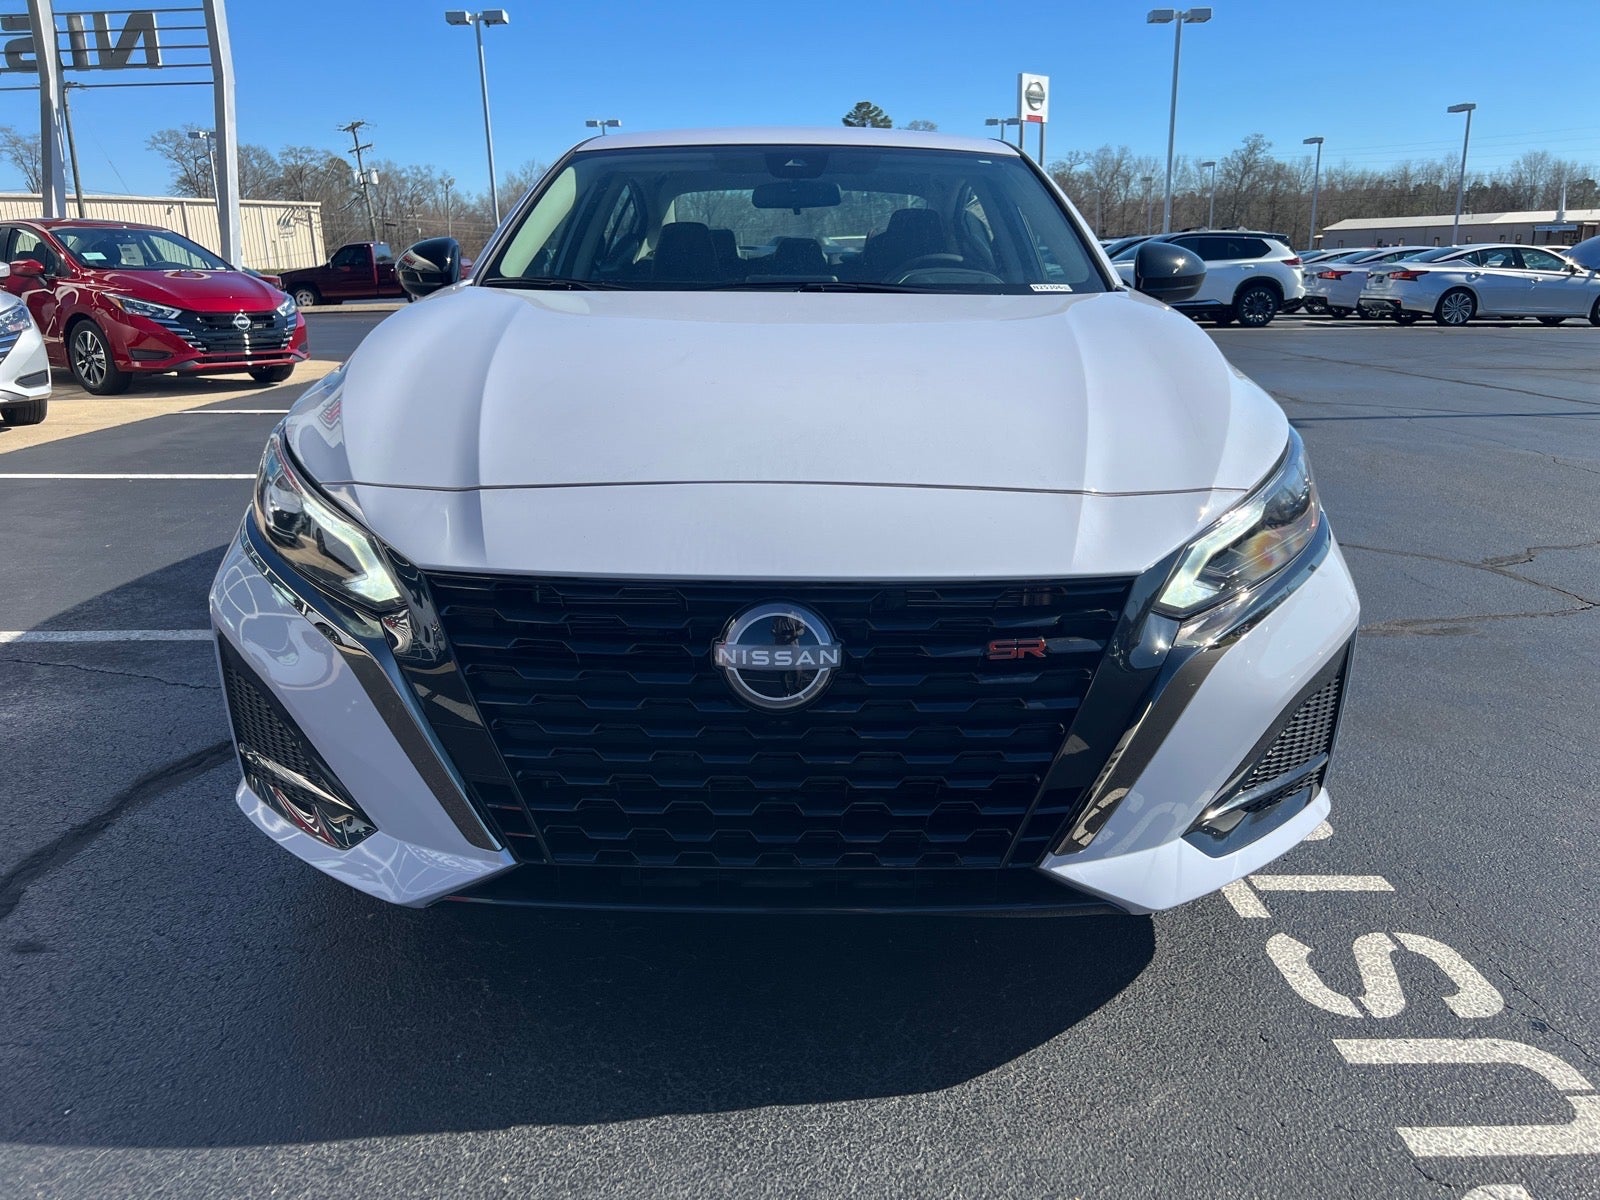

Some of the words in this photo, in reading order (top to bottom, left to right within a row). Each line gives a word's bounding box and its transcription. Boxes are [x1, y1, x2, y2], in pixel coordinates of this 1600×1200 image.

[719, 648, 838, 666] NISSAN
[989, 638, 1046, 659] SR
[1222, 820, 1600, 1200] UST
